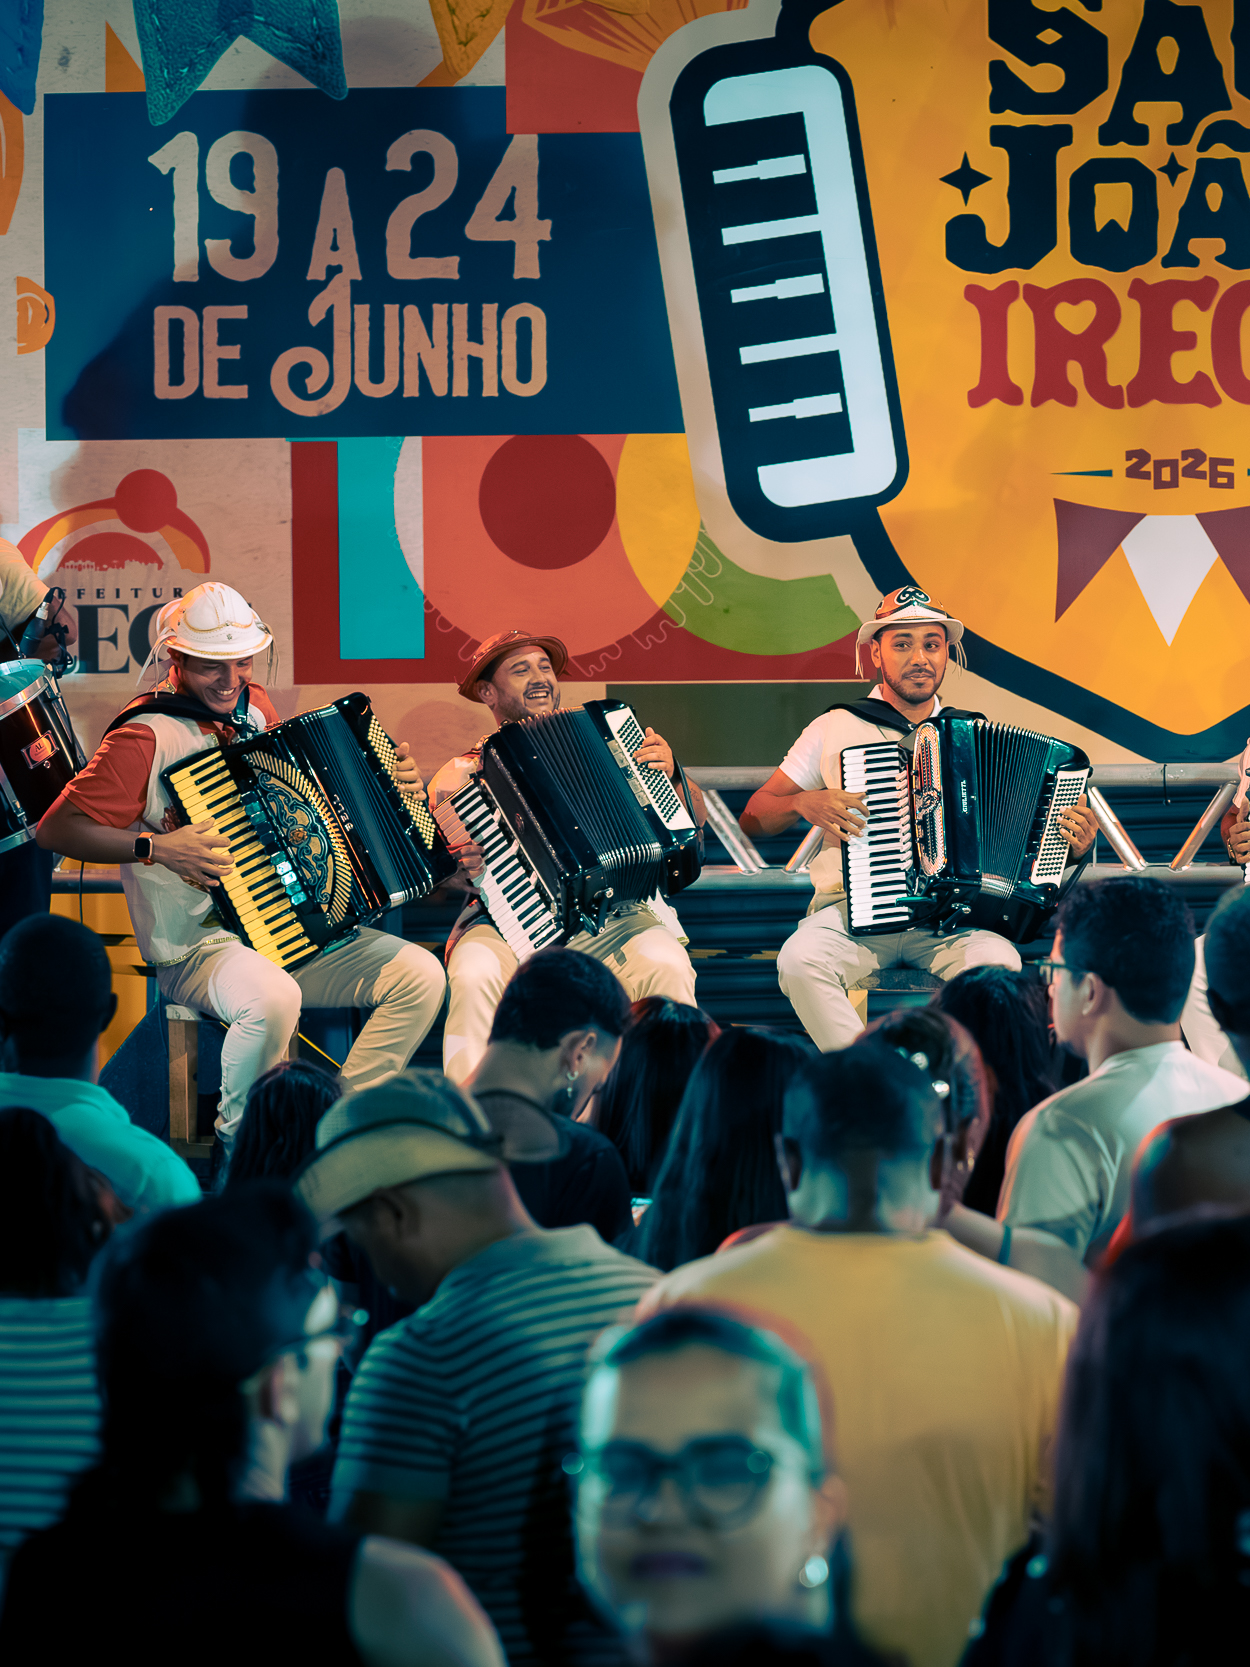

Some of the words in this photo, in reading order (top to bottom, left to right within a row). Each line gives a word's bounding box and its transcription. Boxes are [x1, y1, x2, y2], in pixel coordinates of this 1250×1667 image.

[148, 131, 278, 282] 19
[306, 167, 362, 281] A
[385, 129, 552, 279] 24
[153, 305, 249, 399] DE
[270, 272, 547, 417] JUNHO
[1125, 448, 1235, 490] 2026
[57, 587, 184, 600] EFEITUR
